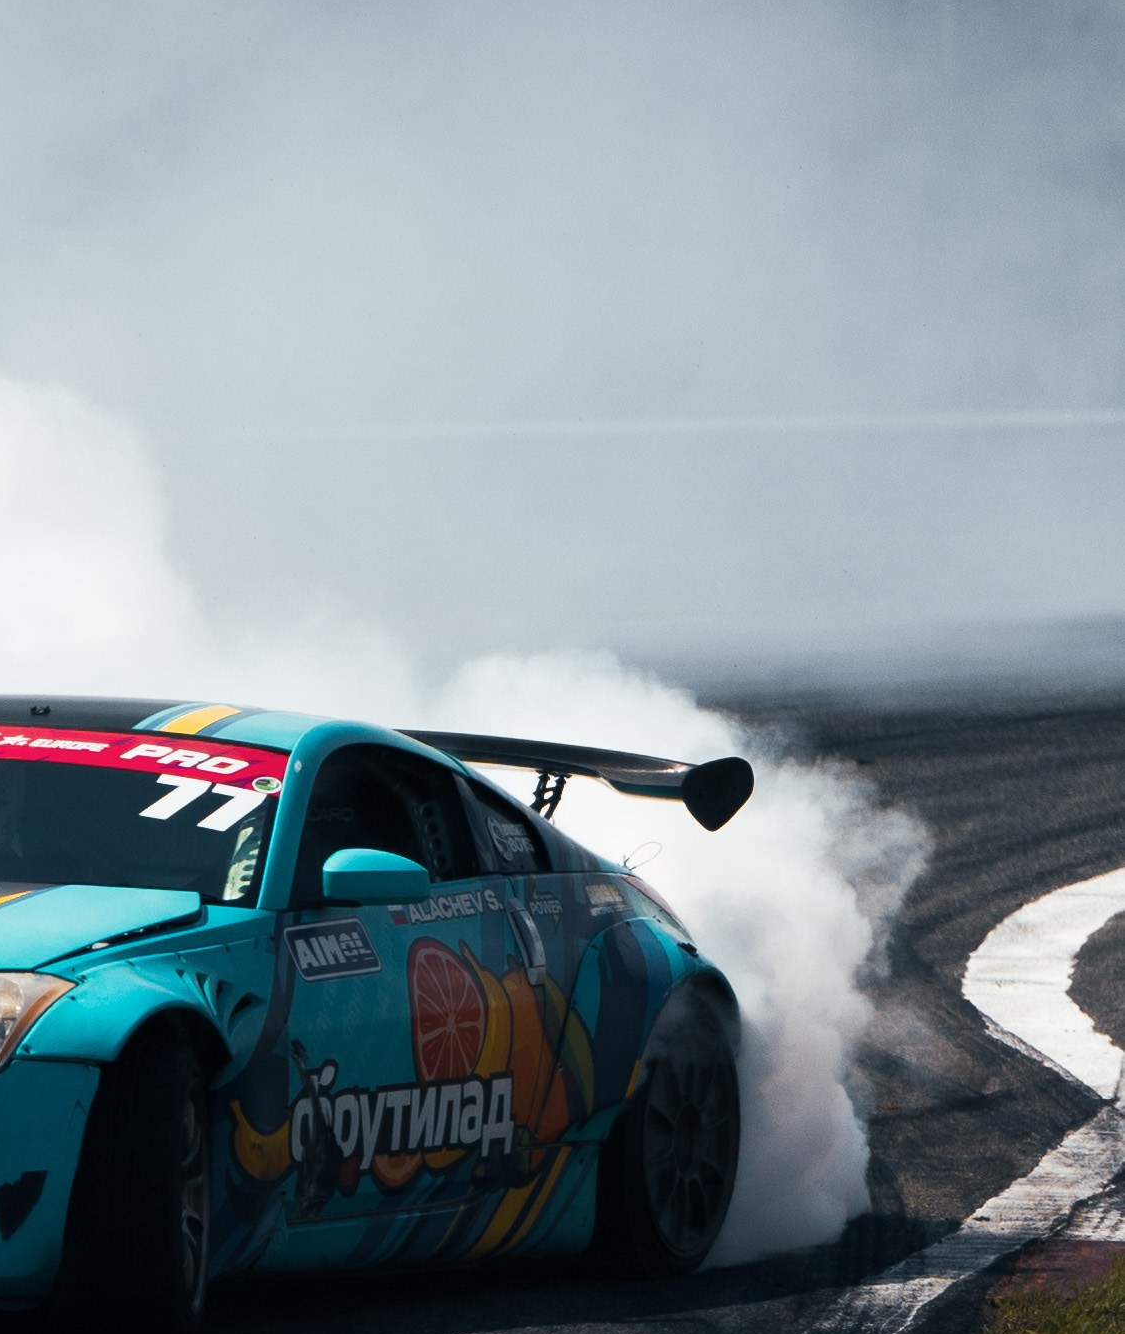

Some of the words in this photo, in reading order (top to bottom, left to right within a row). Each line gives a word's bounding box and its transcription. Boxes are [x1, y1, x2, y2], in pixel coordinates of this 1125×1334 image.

[120, 743, 250, 775] PRO
[139, 774, 267, 831] 77
[409, 891, 483, 924] ALACHEV
[529, 899, 564, 916] POWER
